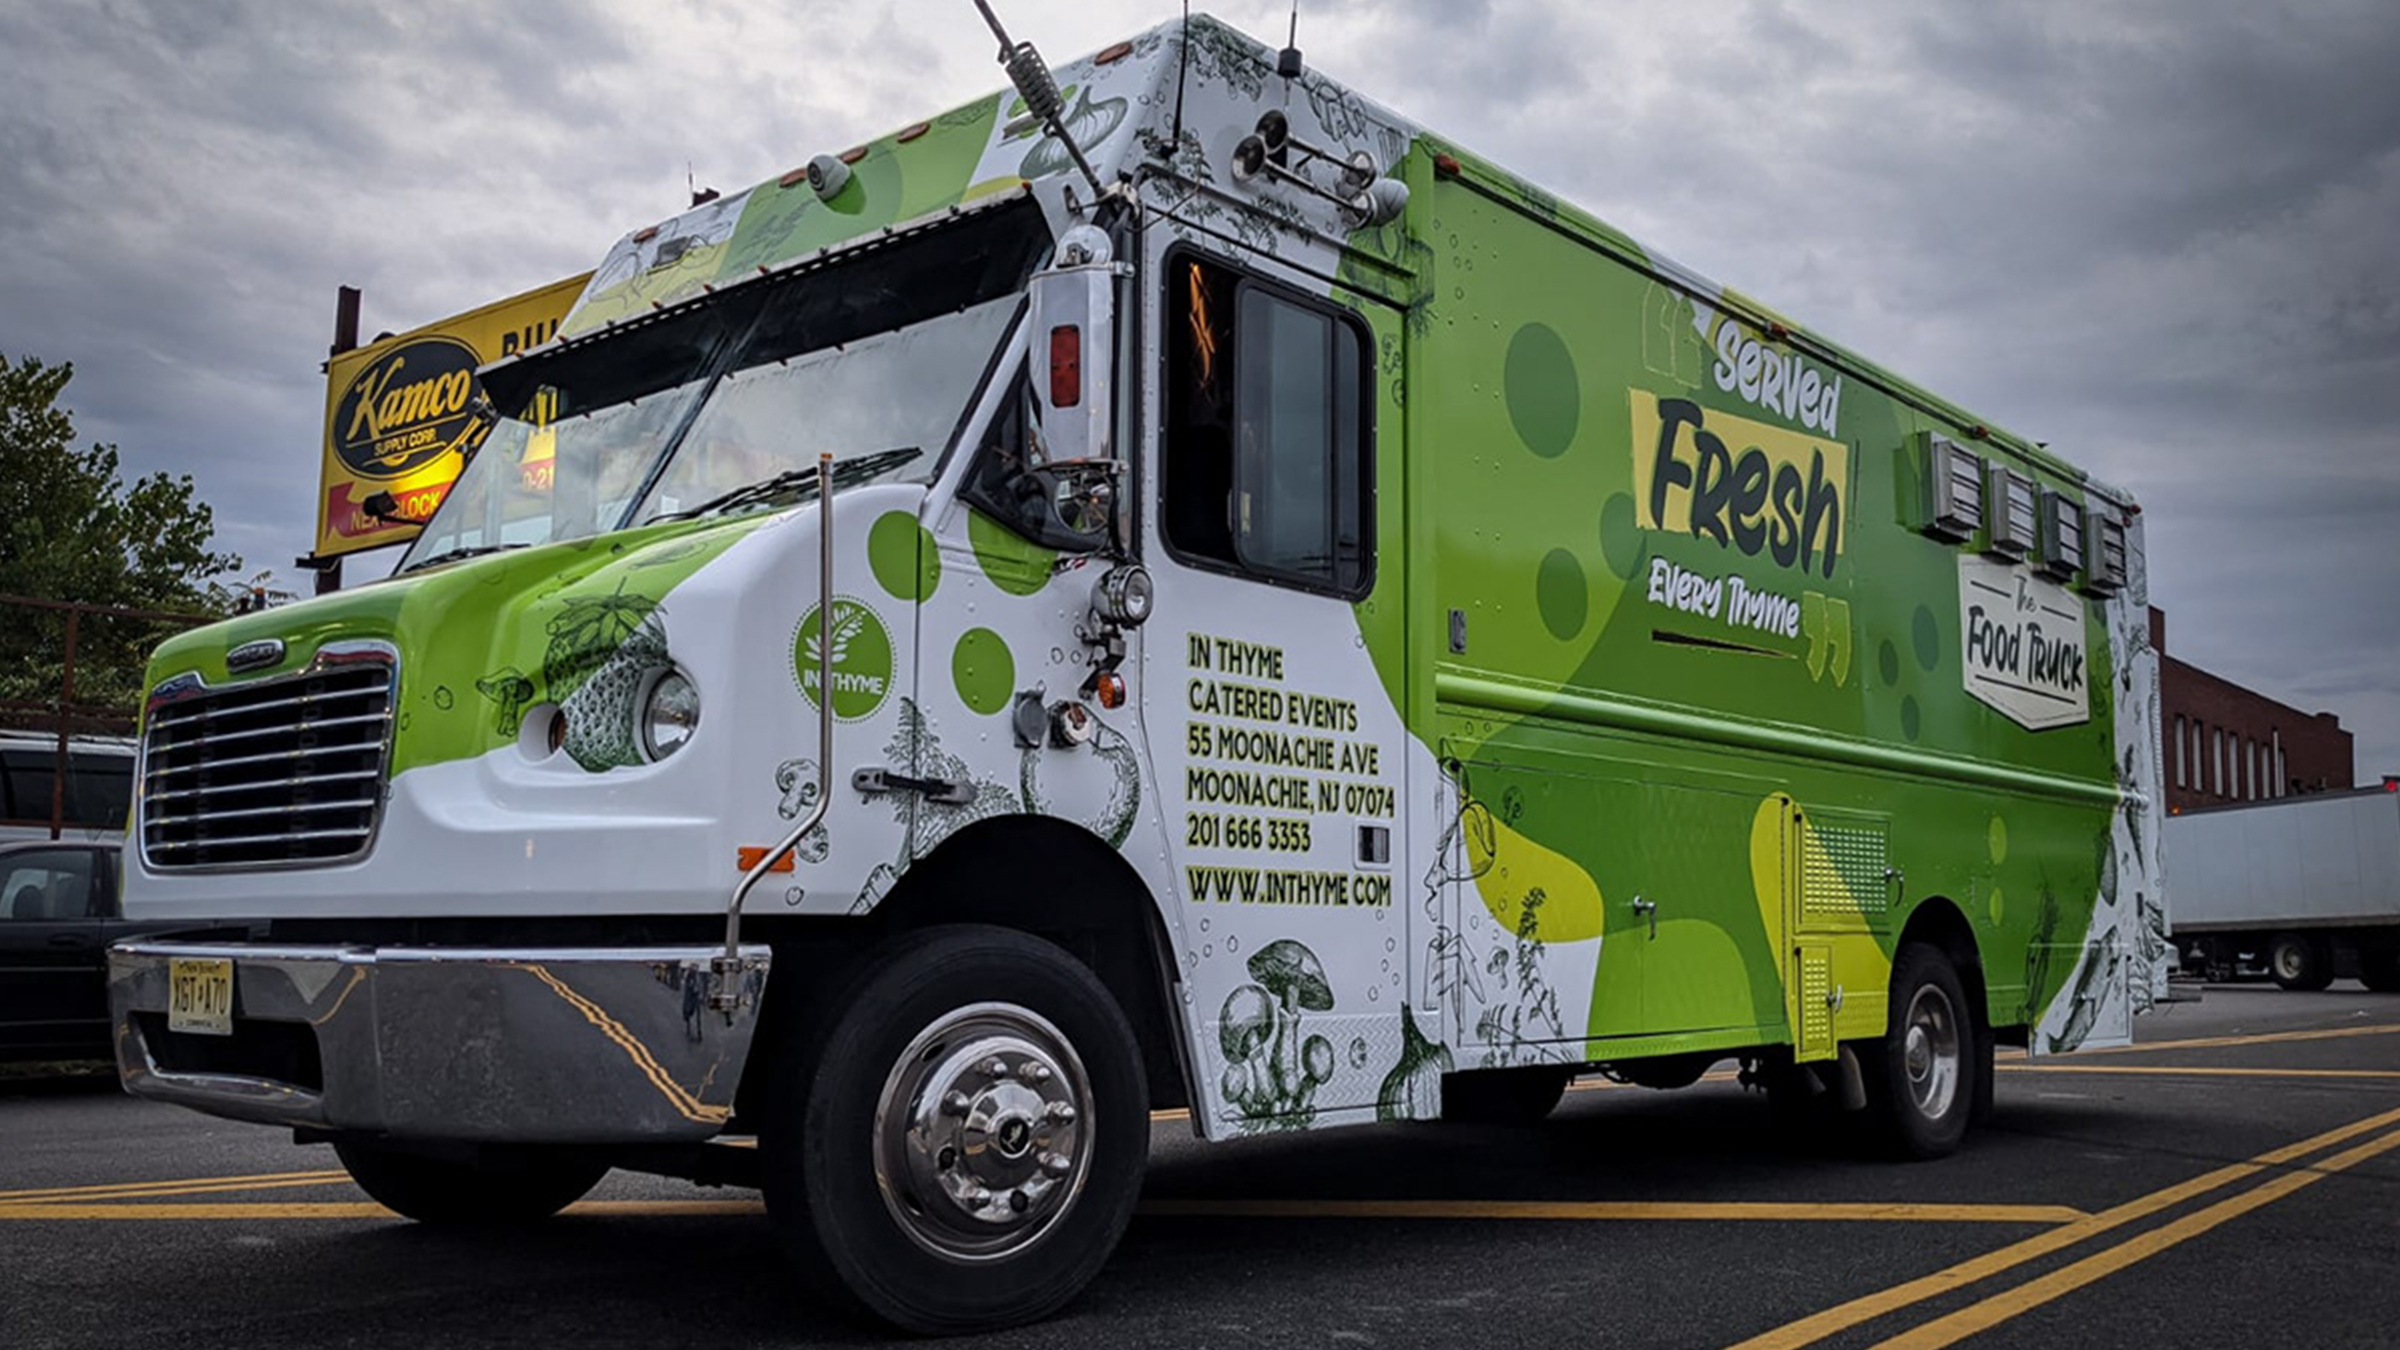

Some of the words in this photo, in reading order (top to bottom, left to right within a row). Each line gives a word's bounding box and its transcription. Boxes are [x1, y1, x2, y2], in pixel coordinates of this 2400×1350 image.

[345, 356, 471, 441] Kamco
[374, 436, 407, 457] SUPPLY
[2014, 574, 2037, 612] The
[804, 669, 822, 689] IN
[1188, 634, 1210, 669] IN
[1216, 637, 1283, 680] THYME
[1189, 680, 1283, 722] CATERED
[1289, 693, 1358, 732] EVENTS
[1187, 724, 1212, 757] 55
[1218, 728, 1334, 771] MOONACHIE
[1340, 744, 1379, 776] AVE
[1187, 769, 1315, 813] MOONACHIE,
[1318, 779, 1340, 813] NJ
[1345, 785, 1395, 818] 07074
[1187, 812, 1221, 847] 201
[1225, 815, 1263, 849] 666
[1267, 819, 1312, 852] 3353
